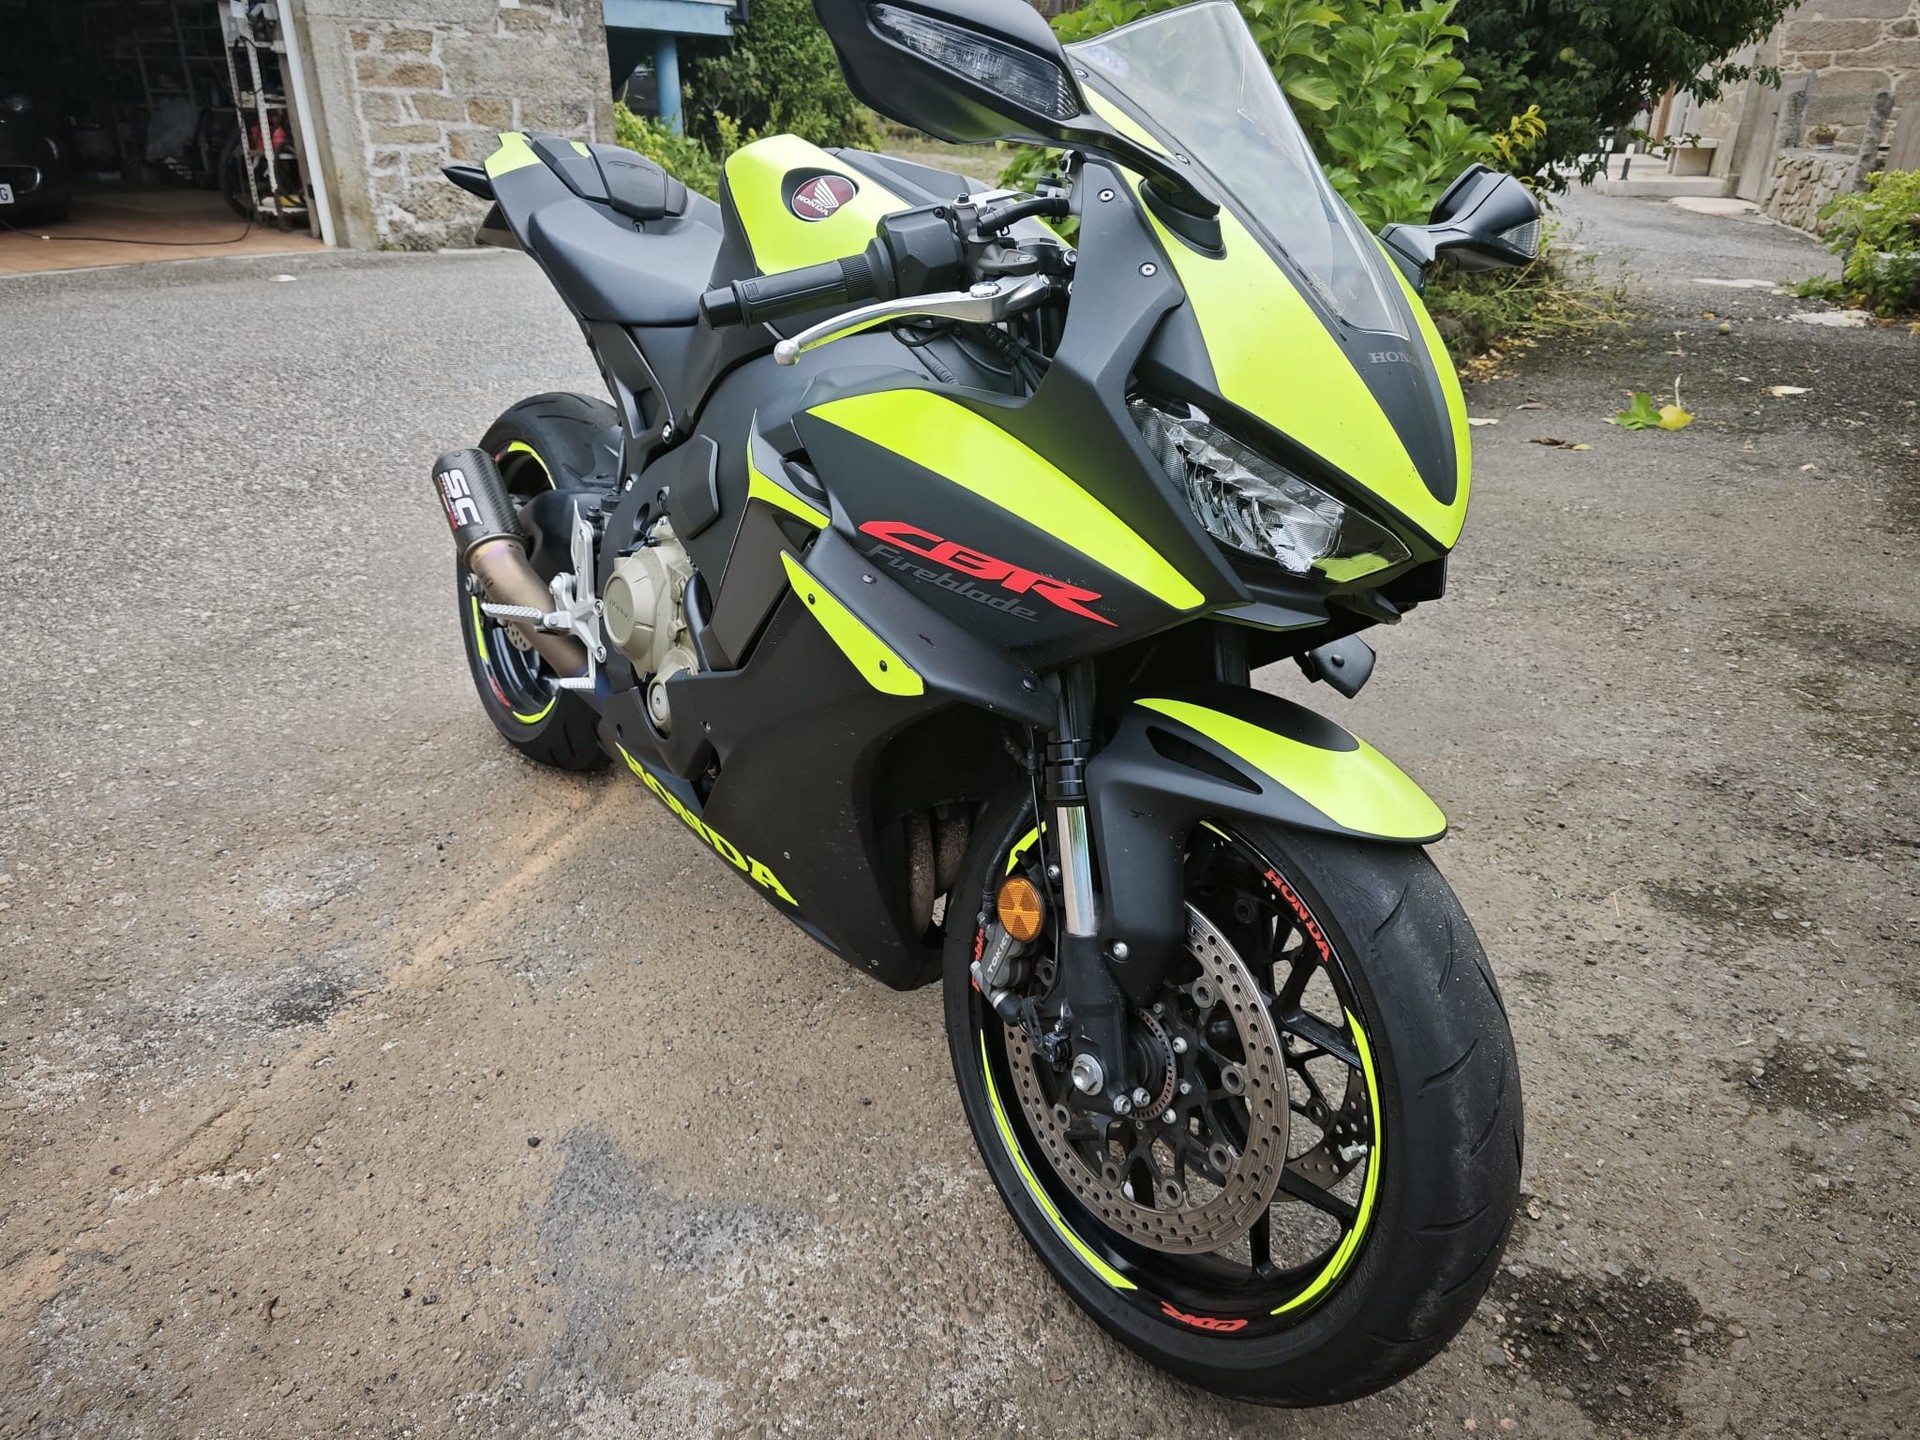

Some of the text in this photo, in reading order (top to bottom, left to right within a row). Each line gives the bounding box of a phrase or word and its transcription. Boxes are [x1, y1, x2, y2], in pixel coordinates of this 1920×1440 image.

[796, 194, 829, 216] HONDA
[1368, 351, 1412, 364] HON
[443, 469, 484, 526] SC
[858, 520, 1119, 627] CBR
[867, 543, 1039, 623] Fireblade
[1264, 868, 1330, 962] HONDA
